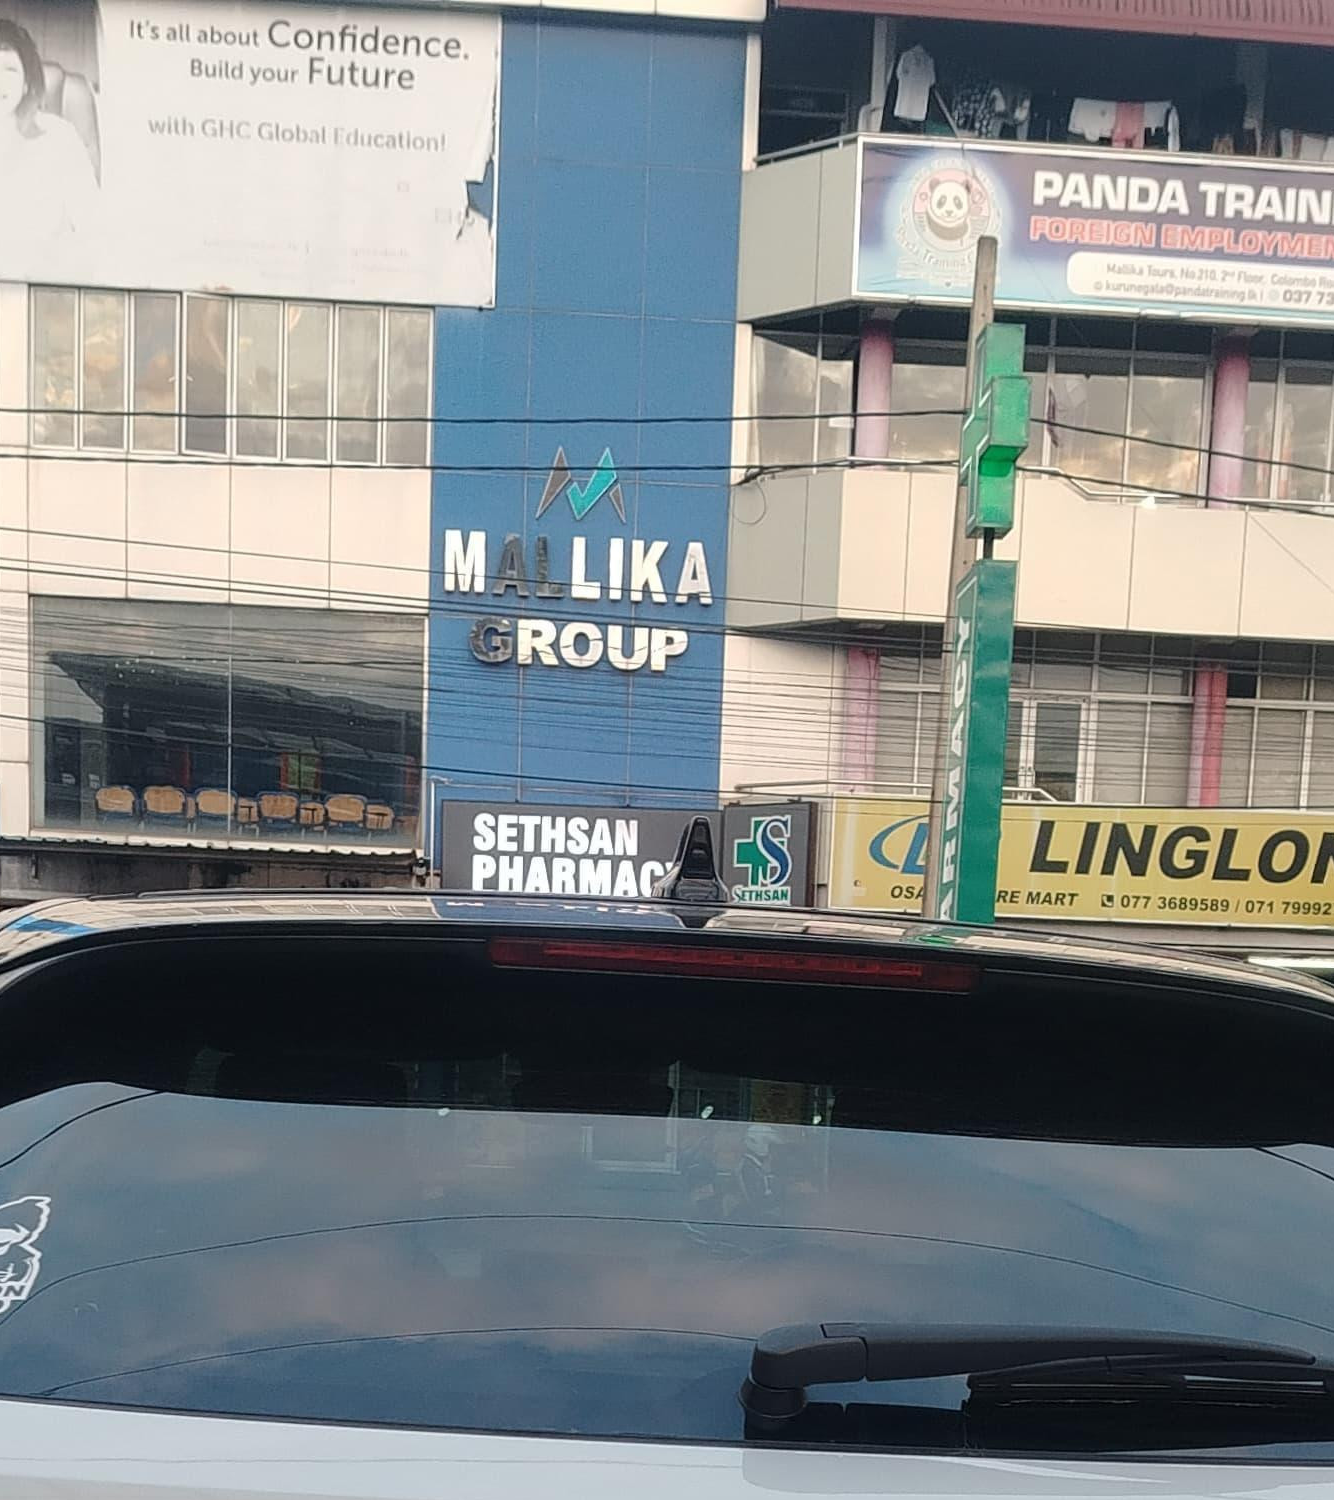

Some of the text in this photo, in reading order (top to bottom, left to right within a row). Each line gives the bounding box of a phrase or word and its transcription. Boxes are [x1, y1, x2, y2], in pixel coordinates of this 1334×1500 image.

[130, 19, 470, 60] It's all about Confidence.
[190, 56, 415, 90] Build your Future
[148, 116, 447, 152] with GHC Global Education!
[1032, 170, 1190, 215] PANDA
[1029, 215, 1157, 249] FOREIGN
[1106, 262, 1144, 276] Mallika
[1270, 273, 1317, 288] Colombo
[1282, 288, 1310, 304] 037
[443, 528, 714, 606] MALLIKA
[470, 616, 689, 672] GROUP
[939, 615, 970, 922] ARMACY
[472, 812, 639, 857] SETHSAN
[472, 853, 673, 898] PHARMAC
[733, 886, 790, 902] SETHSAN
[996, 889, 1021, 905] RE
[1025, 890, 1079, 907] MART
[1120, 894, 1151, 909] 077
[1157, 896, 1230, 912] 3689589
[1245, 899, 1274, 914] 071
